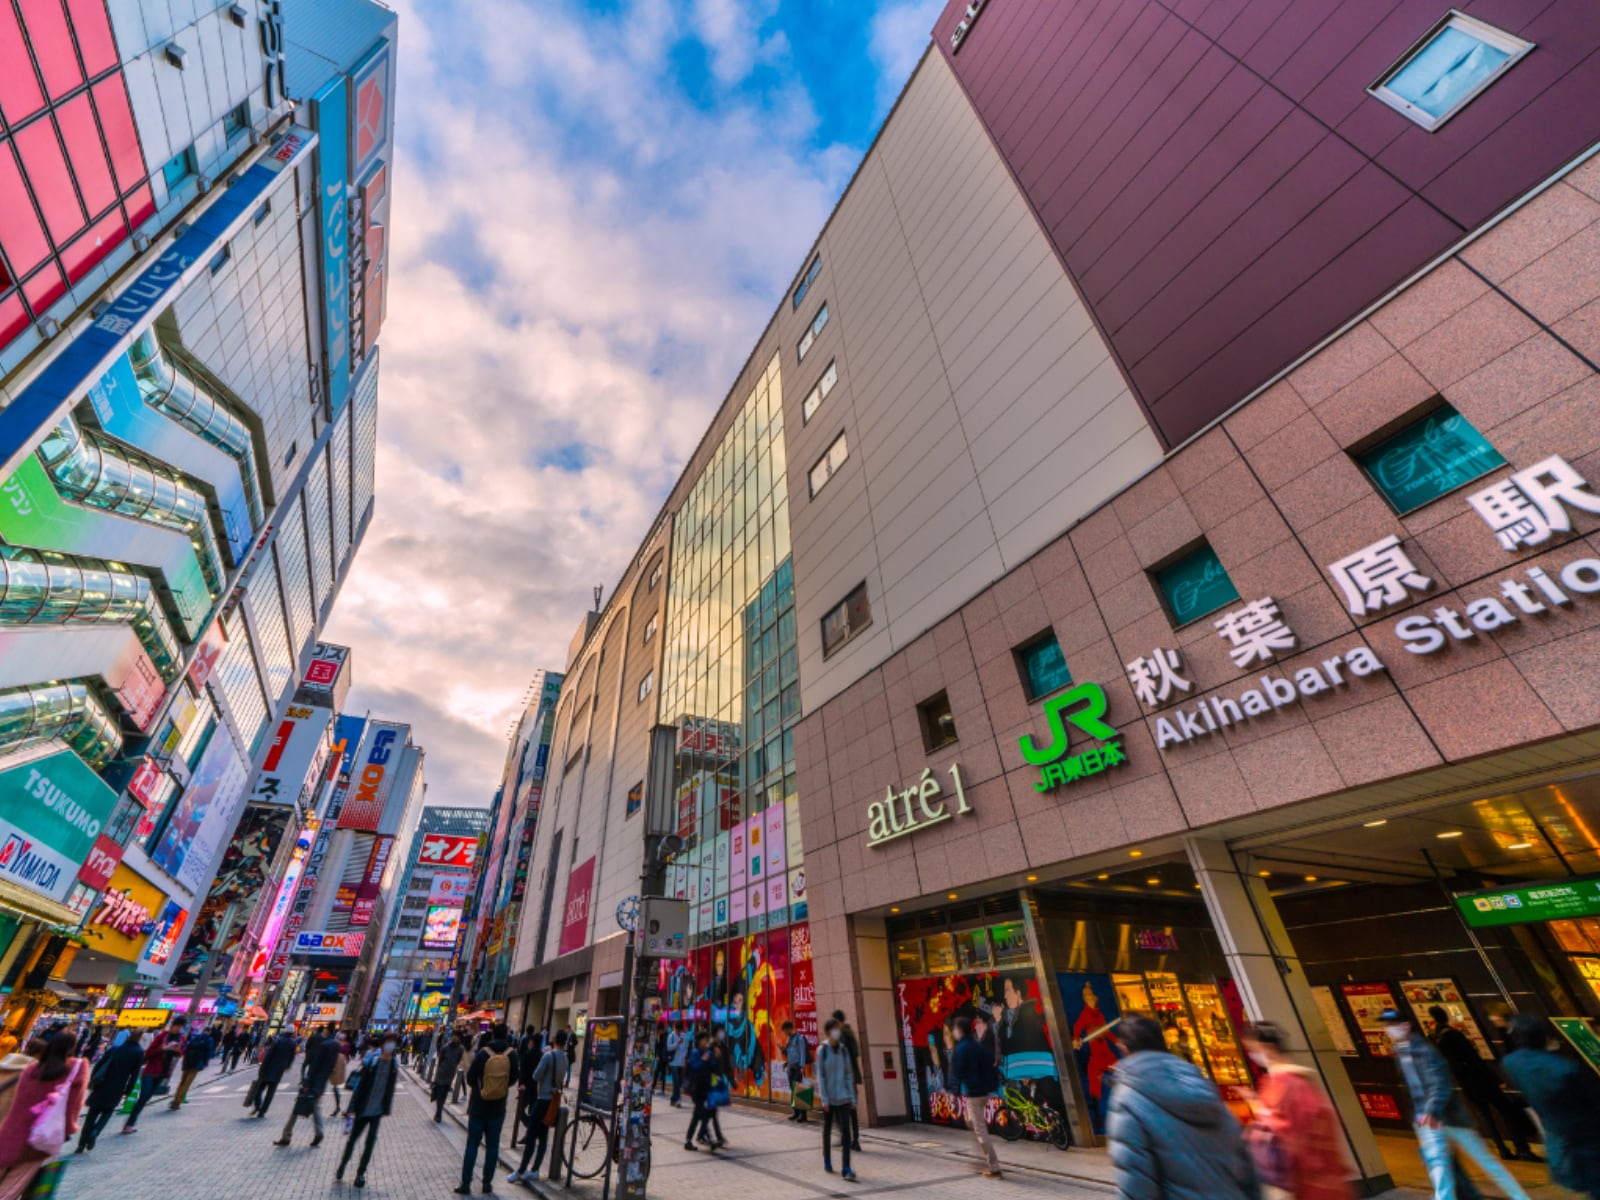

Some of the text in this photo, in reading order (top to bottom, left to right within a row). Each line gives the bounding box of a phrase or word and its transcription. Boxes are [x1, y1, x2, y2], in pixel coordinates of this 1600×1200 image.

[1126, 453, 1600, 708] 秋葉原駅
[1018, 681, 1119, 766] JR
[1154, 644, 1385, 750] Akihabara
[24, 767, 101, 838] TSUKUMO
[1033, 740, 1128, 793] JR東日本
[867, 768, 950, 846] atré
[9, 839, 61, 891] YAMADA
